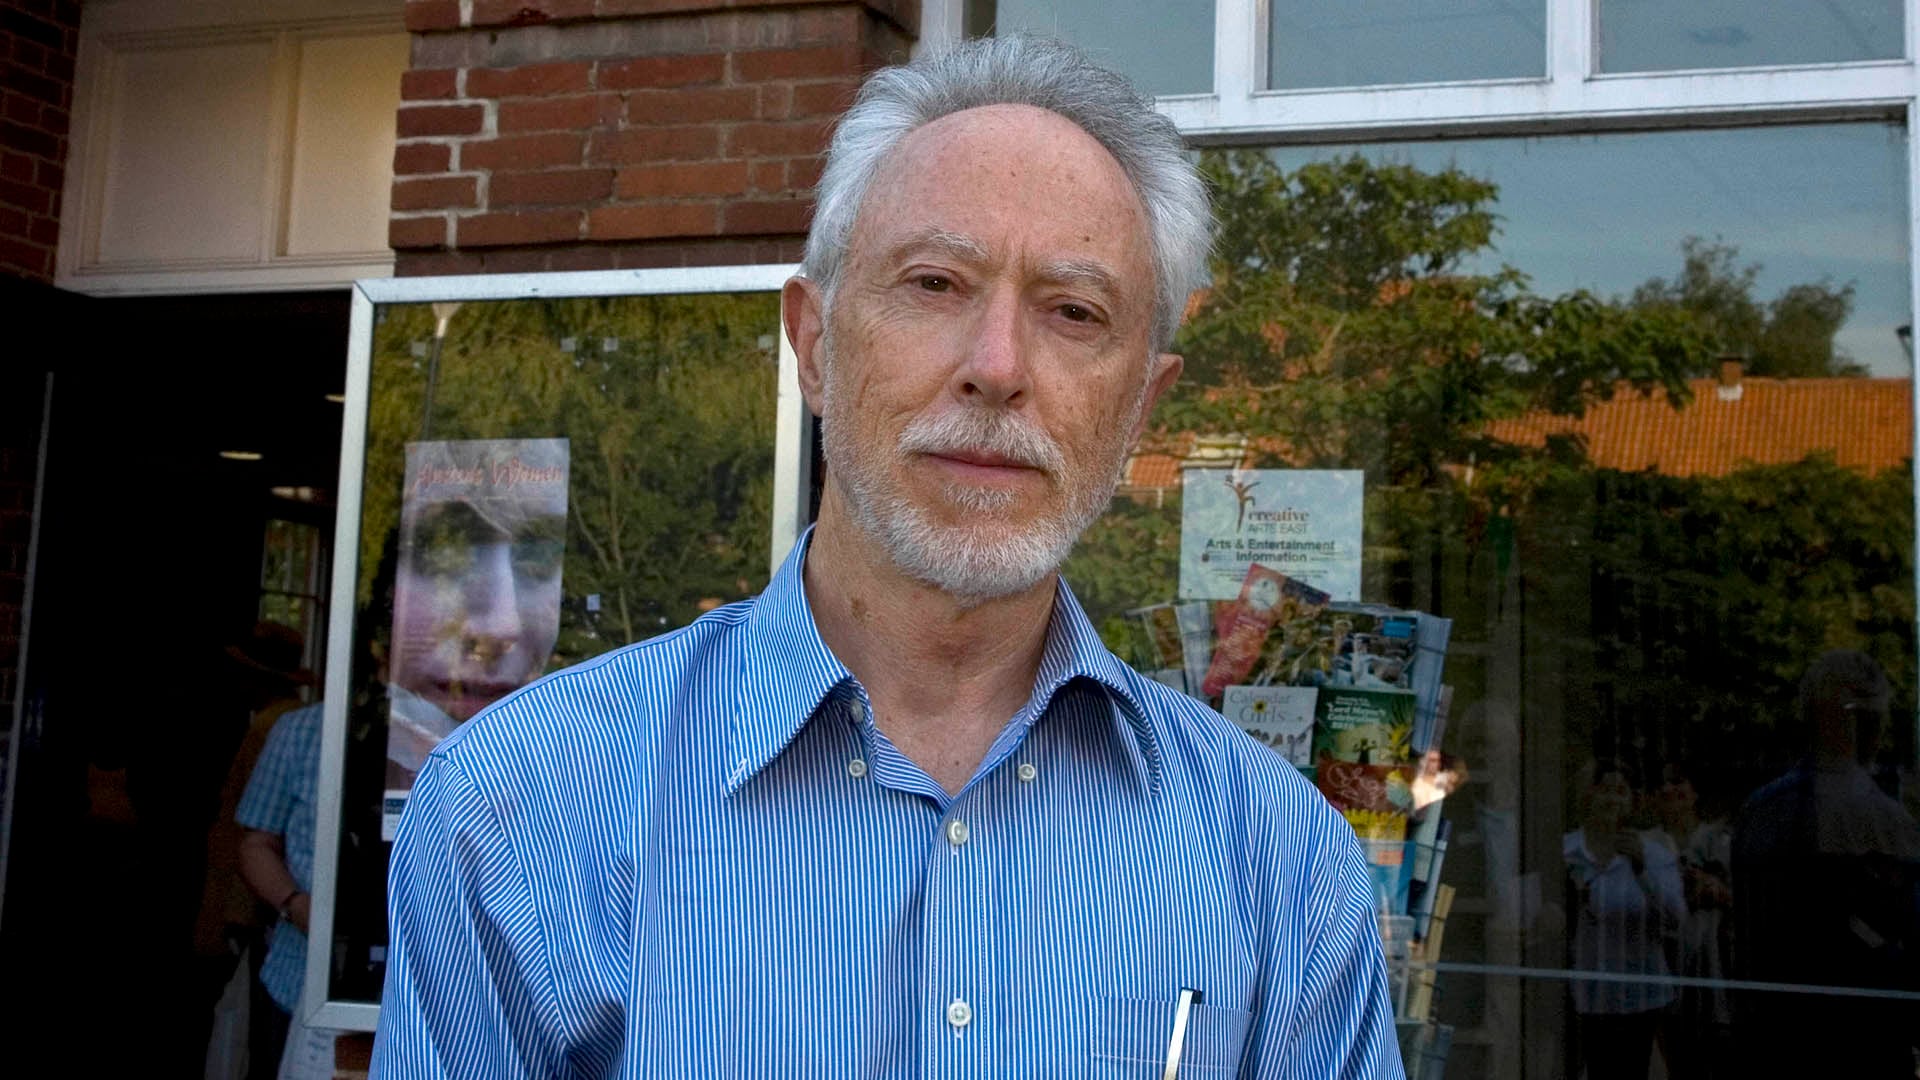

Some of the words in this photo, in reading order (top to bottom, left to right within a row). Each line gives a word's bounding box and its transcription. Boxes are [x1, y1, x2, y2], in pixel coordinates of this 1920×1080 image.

[1248, 507, 1310, 521] creative
[1248, 523, 1277, 534] ARTS
[1280, 523, 1308, 534] EAST
[1206, 539, 1232, 550] Arts
[1235, 538, 1244, 550] &
[1248, 539, 1335, 550] Entertainment
[1236, 551, 1308, 562] Information
[1230, 690, 1293, 704] Calendar
[1240, 705, 1286, 723] Girls
